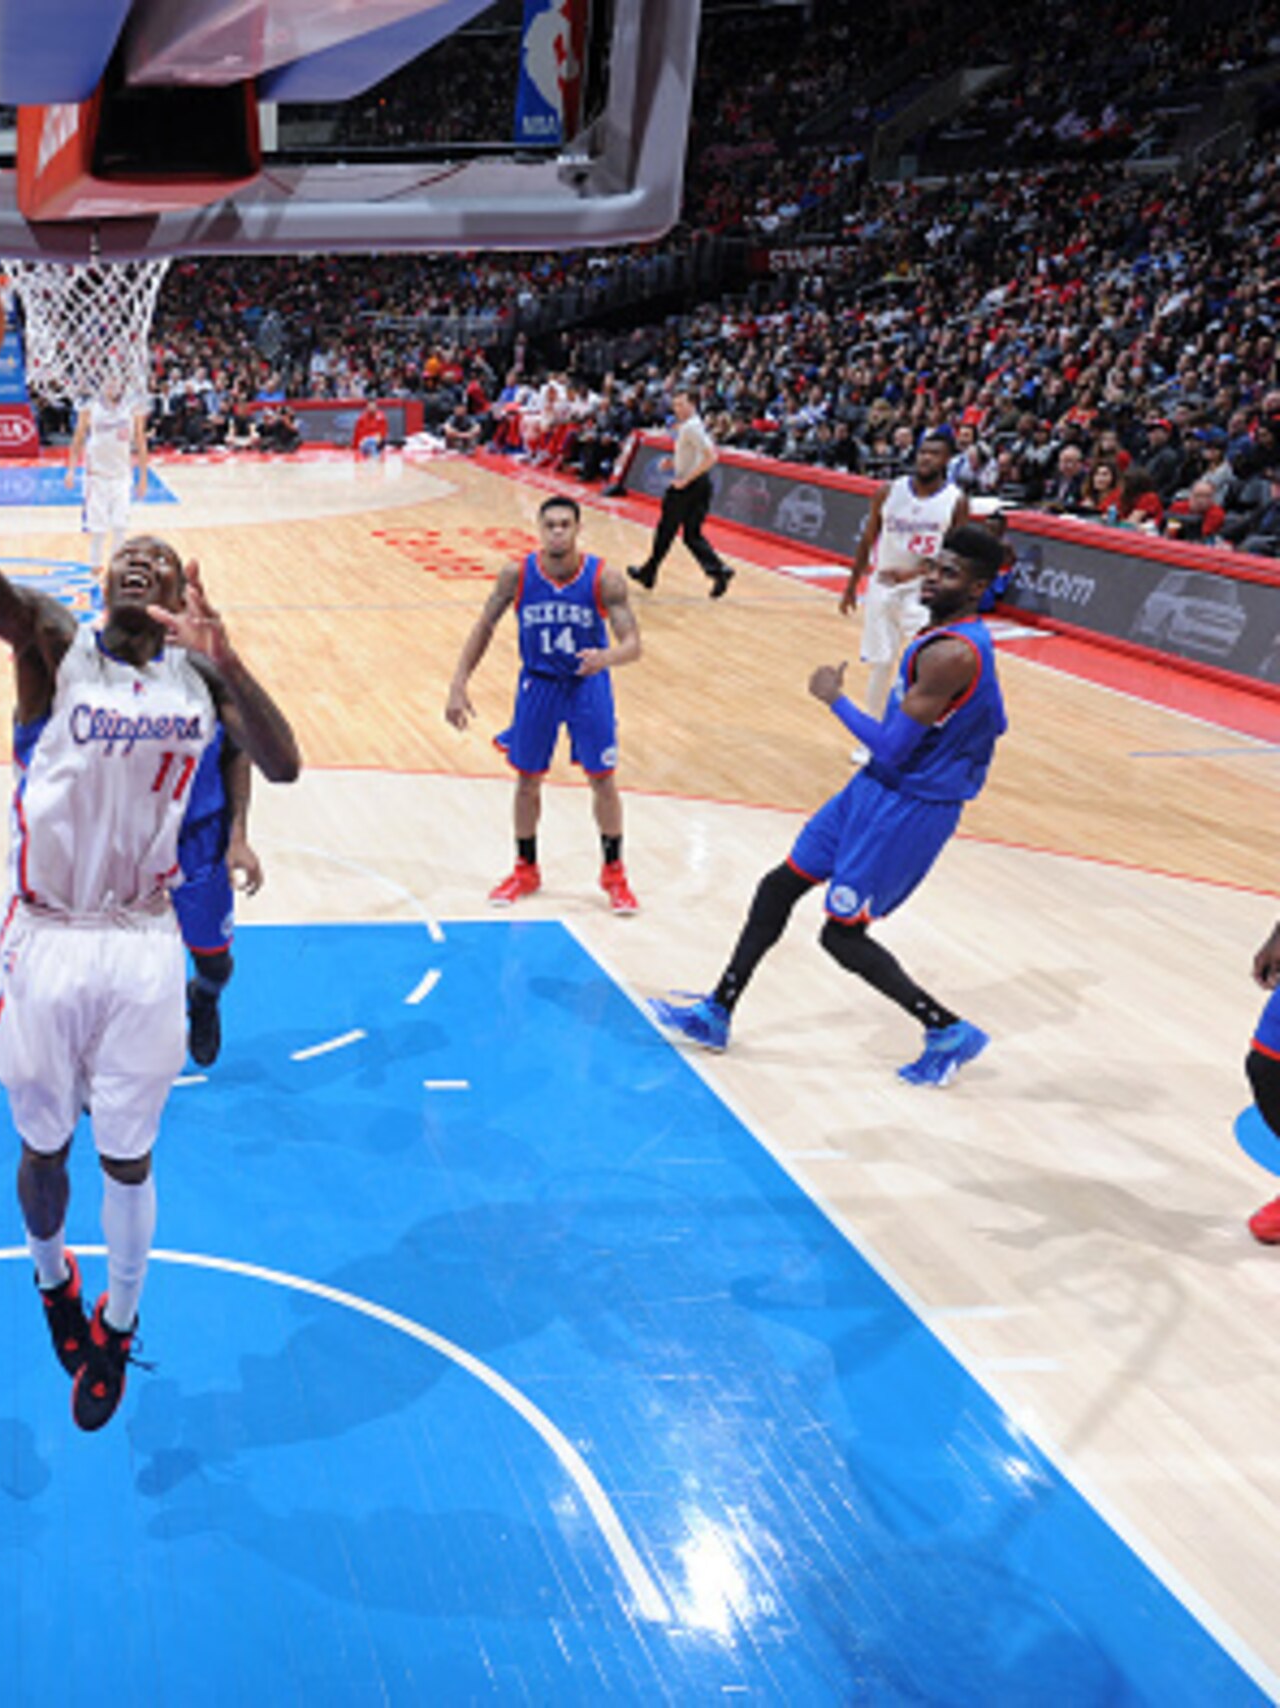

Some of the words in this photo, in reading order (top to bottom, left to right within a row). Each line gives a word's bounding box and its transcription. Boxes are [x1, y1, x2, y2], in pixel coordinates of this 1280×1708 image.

[522, 603, 593, 628] SIXERS
[540, 626, 576, 654] 14
[71, 703, 202, 757] Clippers
[151, 751, 195, 801] 11
